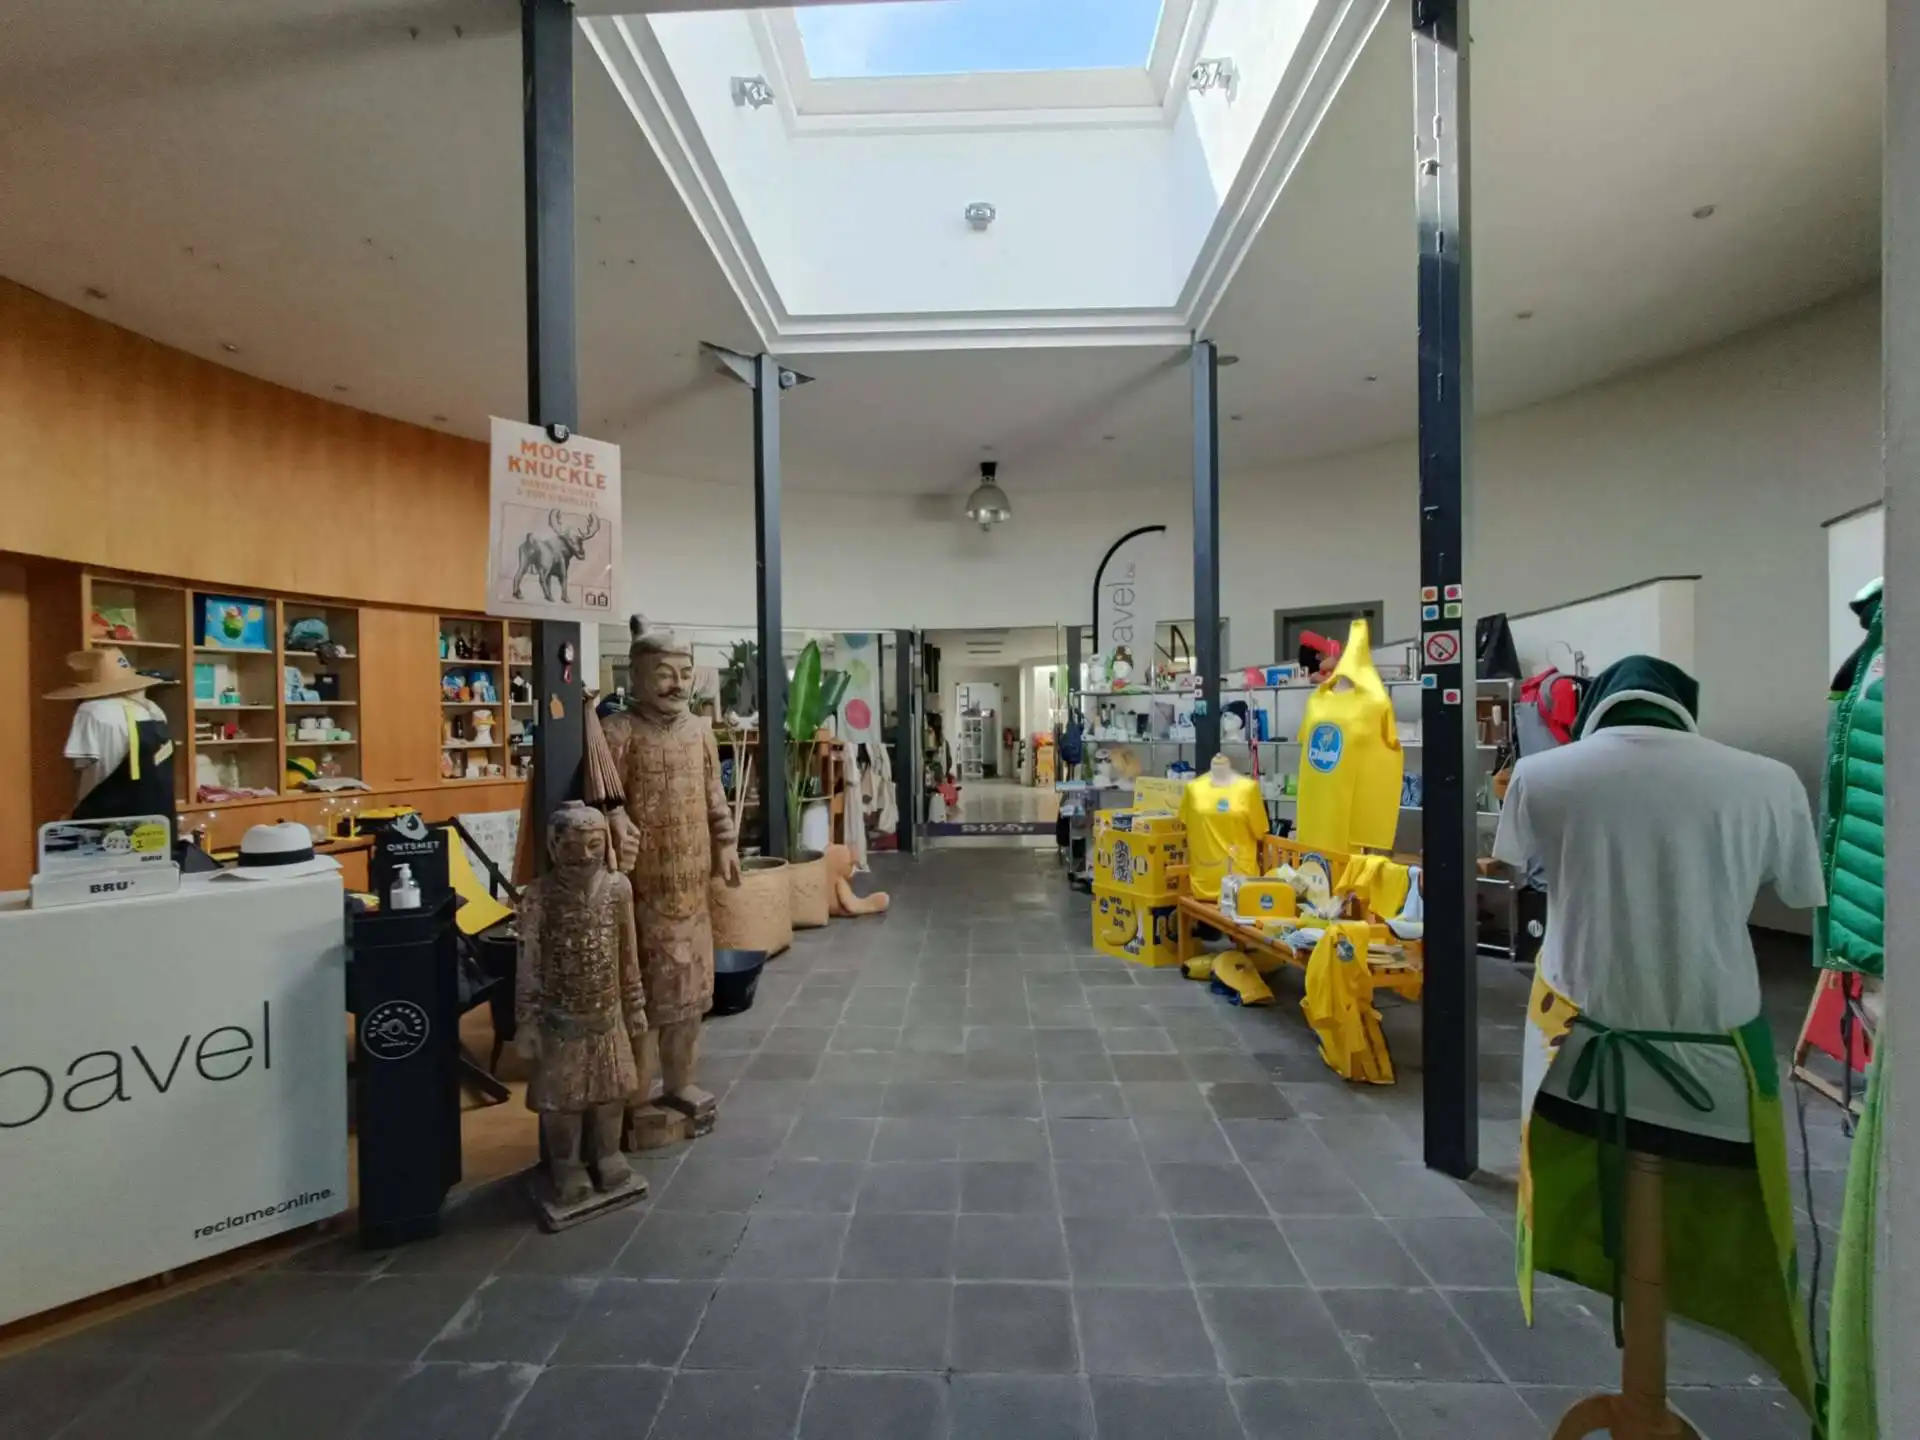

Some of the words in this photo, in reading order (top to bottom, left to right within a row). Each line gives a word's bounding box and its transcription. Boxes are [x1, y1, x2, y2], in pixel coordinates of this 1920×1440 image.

[520, 440, 595, 470] MOOSE
[507, 455, 607, 490] KNUCKLE
[386, 841, 440, 852] ONTSMET
[89, 881, 128, 894] BRU
